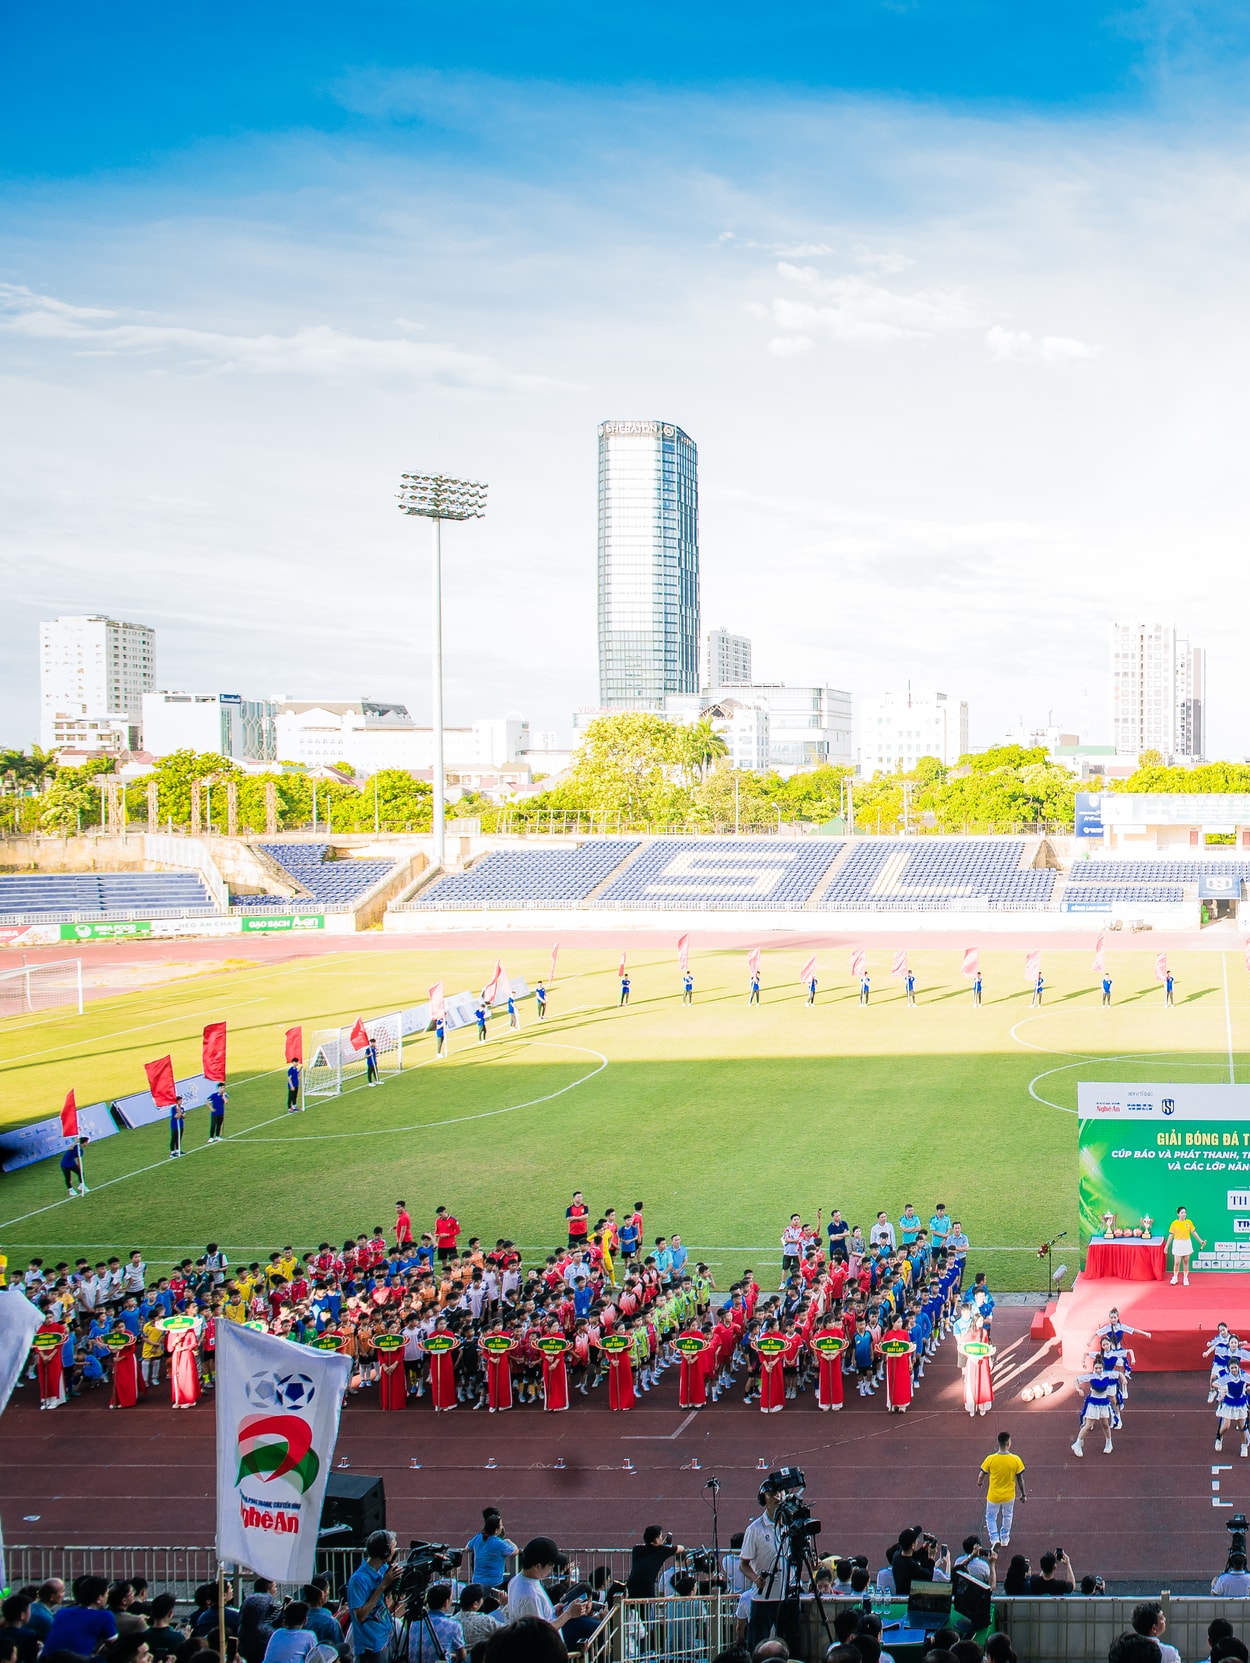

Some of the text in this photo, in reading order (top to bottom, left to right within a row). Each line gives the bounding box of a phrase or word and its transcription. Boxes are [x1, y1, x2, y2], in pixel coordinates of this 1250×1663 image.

[605, 424, 657, 433] SHERATON
[1157, 1129, 1181, 1146] GIẢI
[1186, 1130, 1219, 1146] BÓNG
[1223, 1130, 1239, 1146] ĐÁ
[1112, 1148, 1132, 1159] CÚP
[1134, 1149, 1156, 1159] BÁO
[1159, 1149, 1172, 1159] VÀ
[1174, 1149, 1201, 1159] PHÁT
[1203, 1151, 1239, 1160] THANH,
[1168, 1161, 1181, 1171] VÀ
[1184, 1161, 1204, 1171] CÁC
[1206, 1161, 1226, 1171] LỚP
[1230, 1196, 1247, 1205] TH
[241, 1499, 299, 1534] ghệ An
